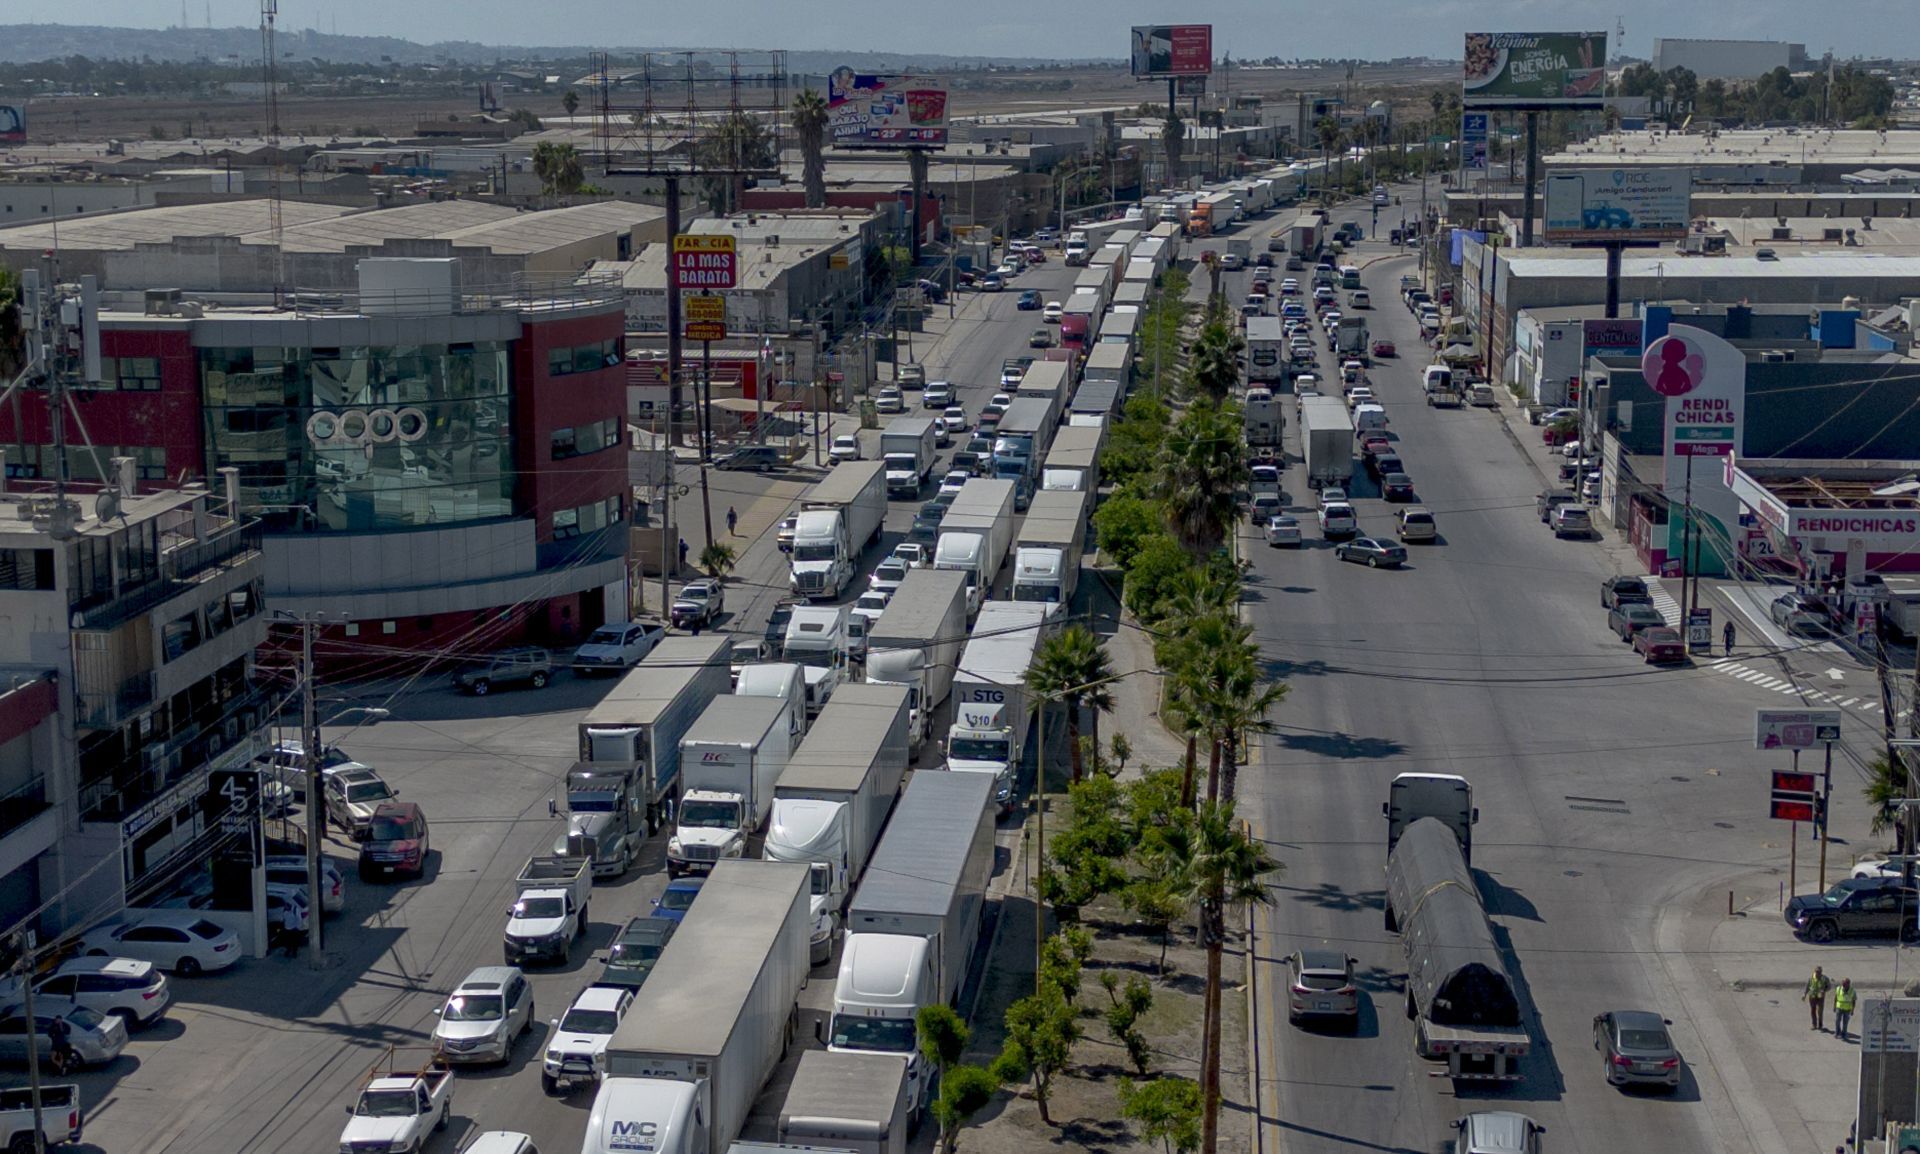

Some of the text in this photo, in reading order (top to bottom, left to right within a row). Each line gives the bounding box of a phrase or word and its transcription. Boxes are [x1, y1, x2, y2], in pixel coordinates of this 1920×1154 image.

[1509, 54, 1569, 75] ENERGÍA
[679, 254, 730, 268] LA MAS
[679, 270, 731, 285] BARATA
[1682, 399, 1730, 411] RENDI
[1675, 411, 1735, 424] CHICAS
[1797, 517, 1916, 533] RENDICHICAS
[973, 689, 1005, 703] STG
[610, 1135, 656, 1145] GROUP
